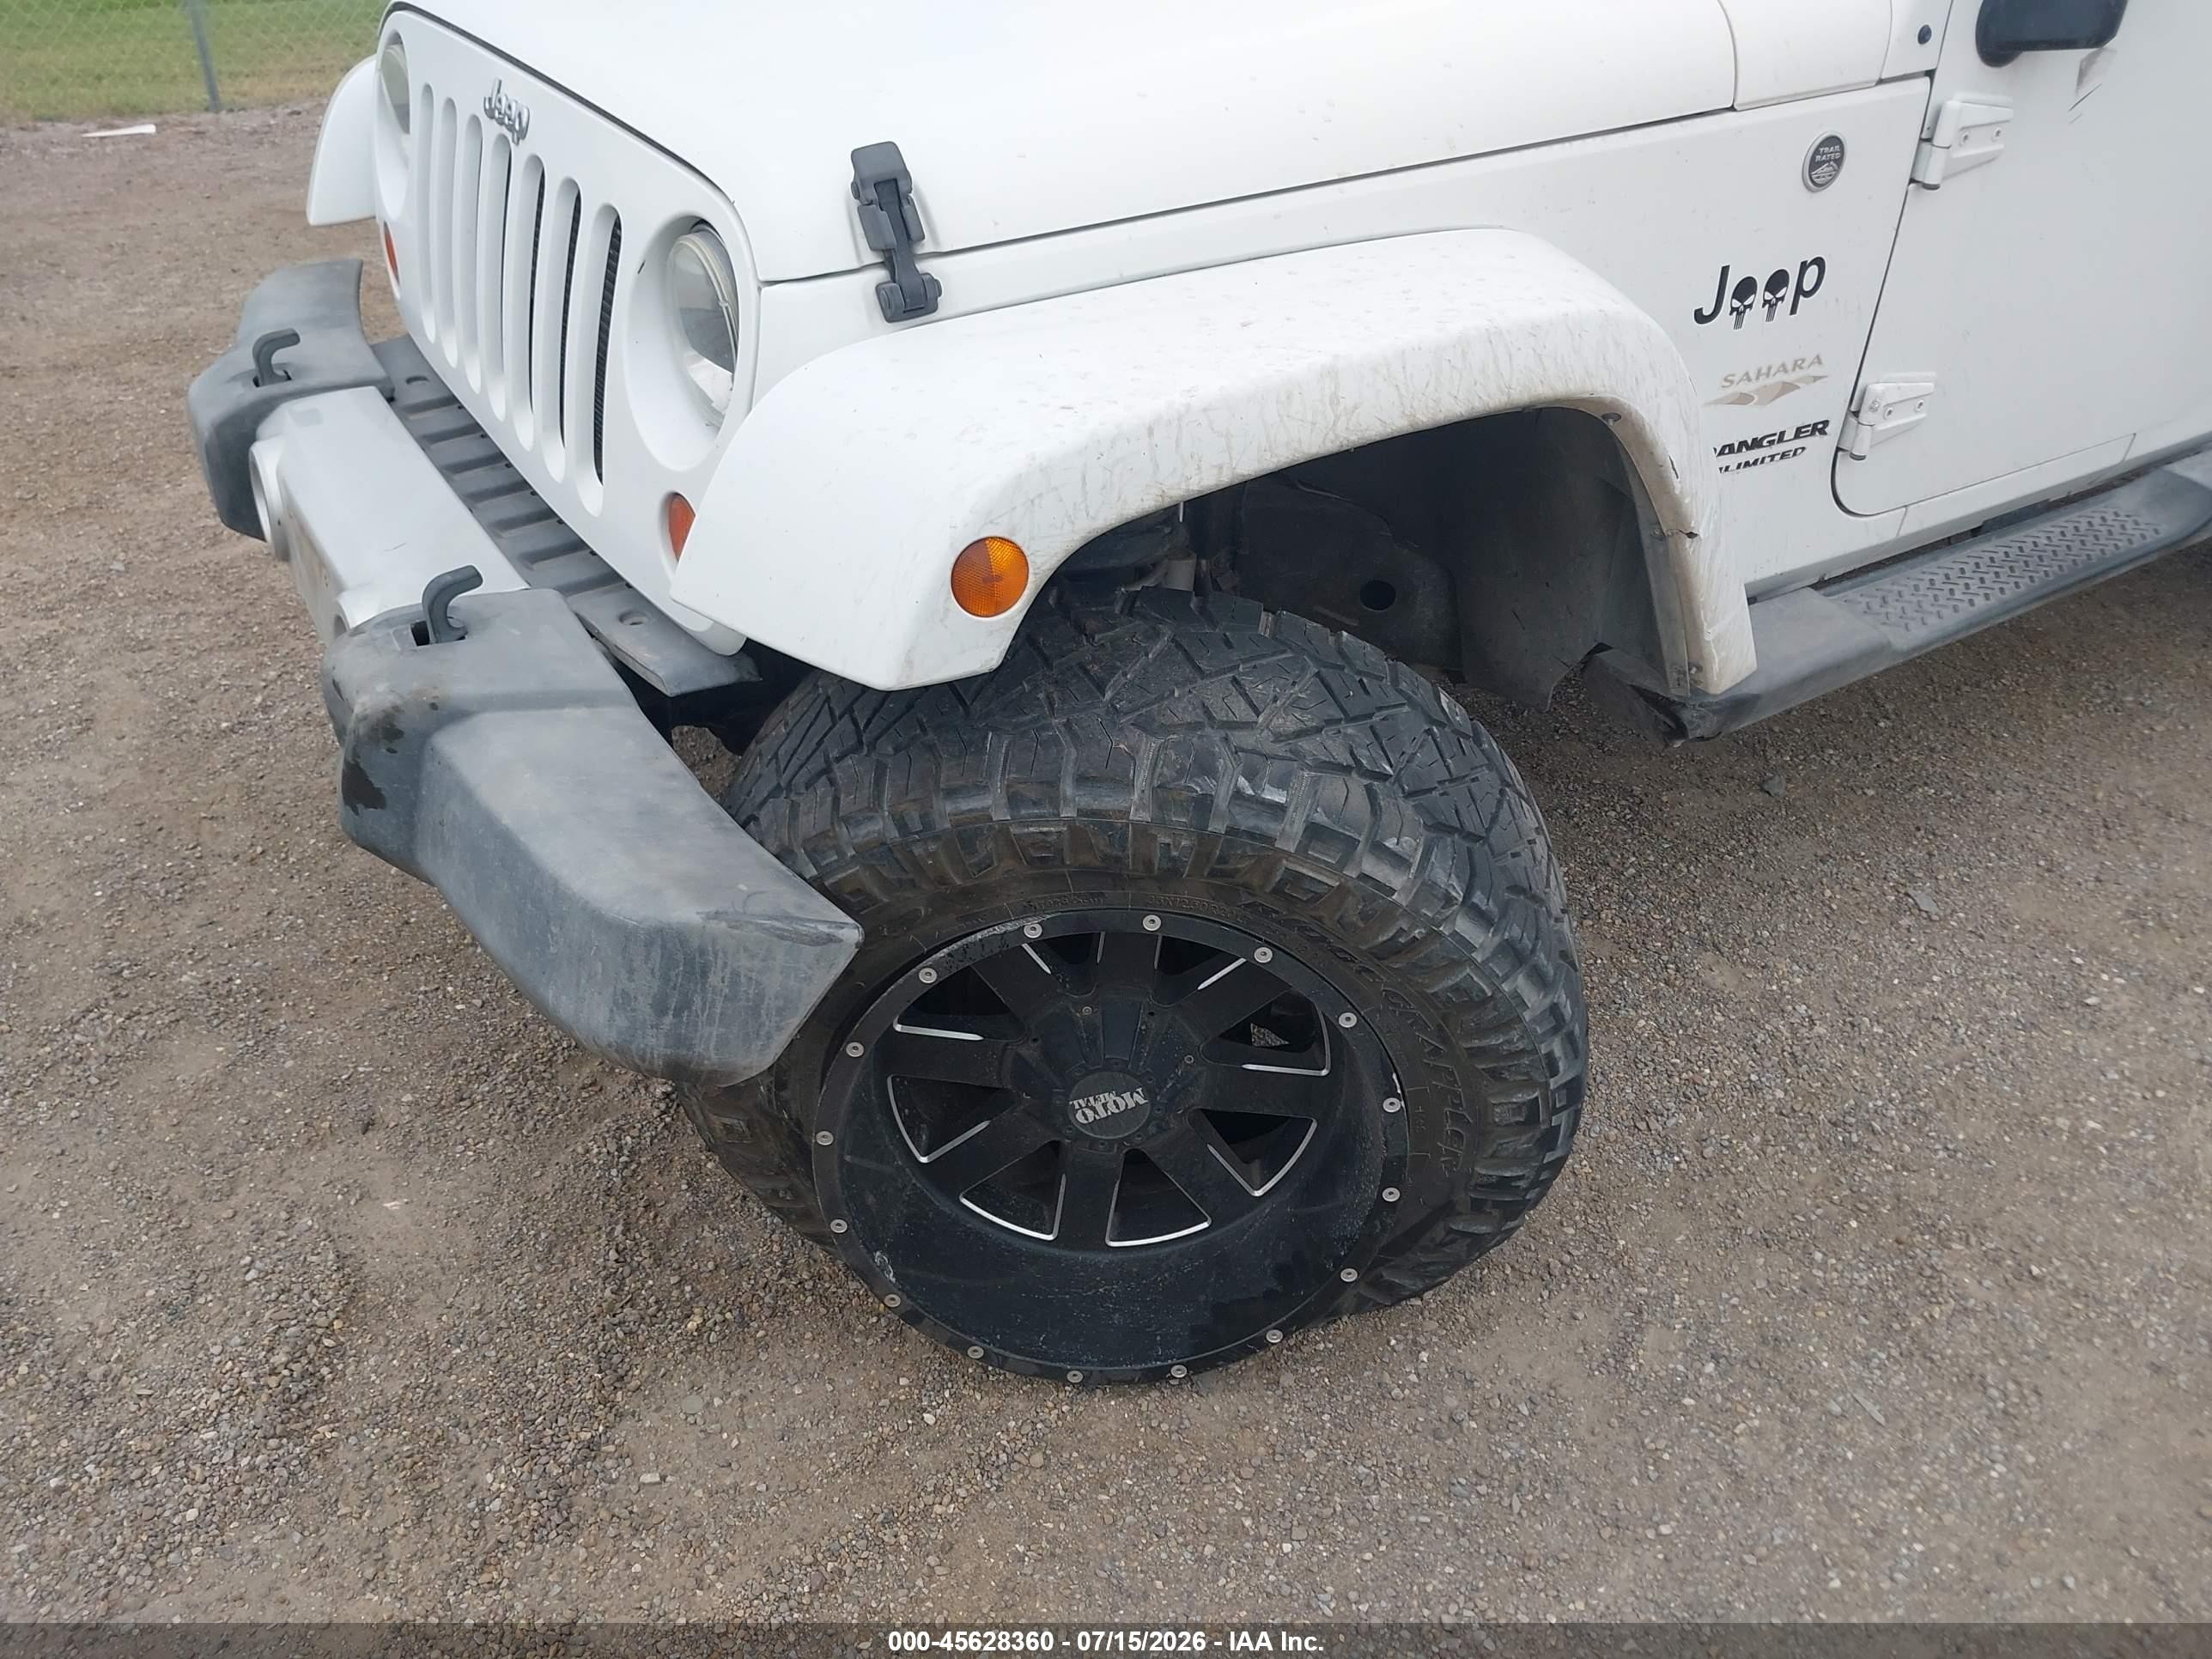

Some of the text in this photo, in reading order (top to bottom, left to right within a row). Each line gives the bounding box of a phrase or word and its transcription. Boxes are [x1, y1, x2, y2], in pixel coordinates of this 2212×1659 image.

[484, 78, 530, 146] Jeep
[1815, 153, 1841, 162] RATED
[1819, 145, 1841, 155] TRAIL
[1693, 255, 1826, 331] Jp
[1721, 354, 1824, 388] SAHARA
[1713, 419, 1831, 458] ANGLER
[1718, 447, 1808, 474] LIMITED
[1069, 1091, 1117, 1109] METAL
[1075, 1087, 1148, 1125] MOTO
